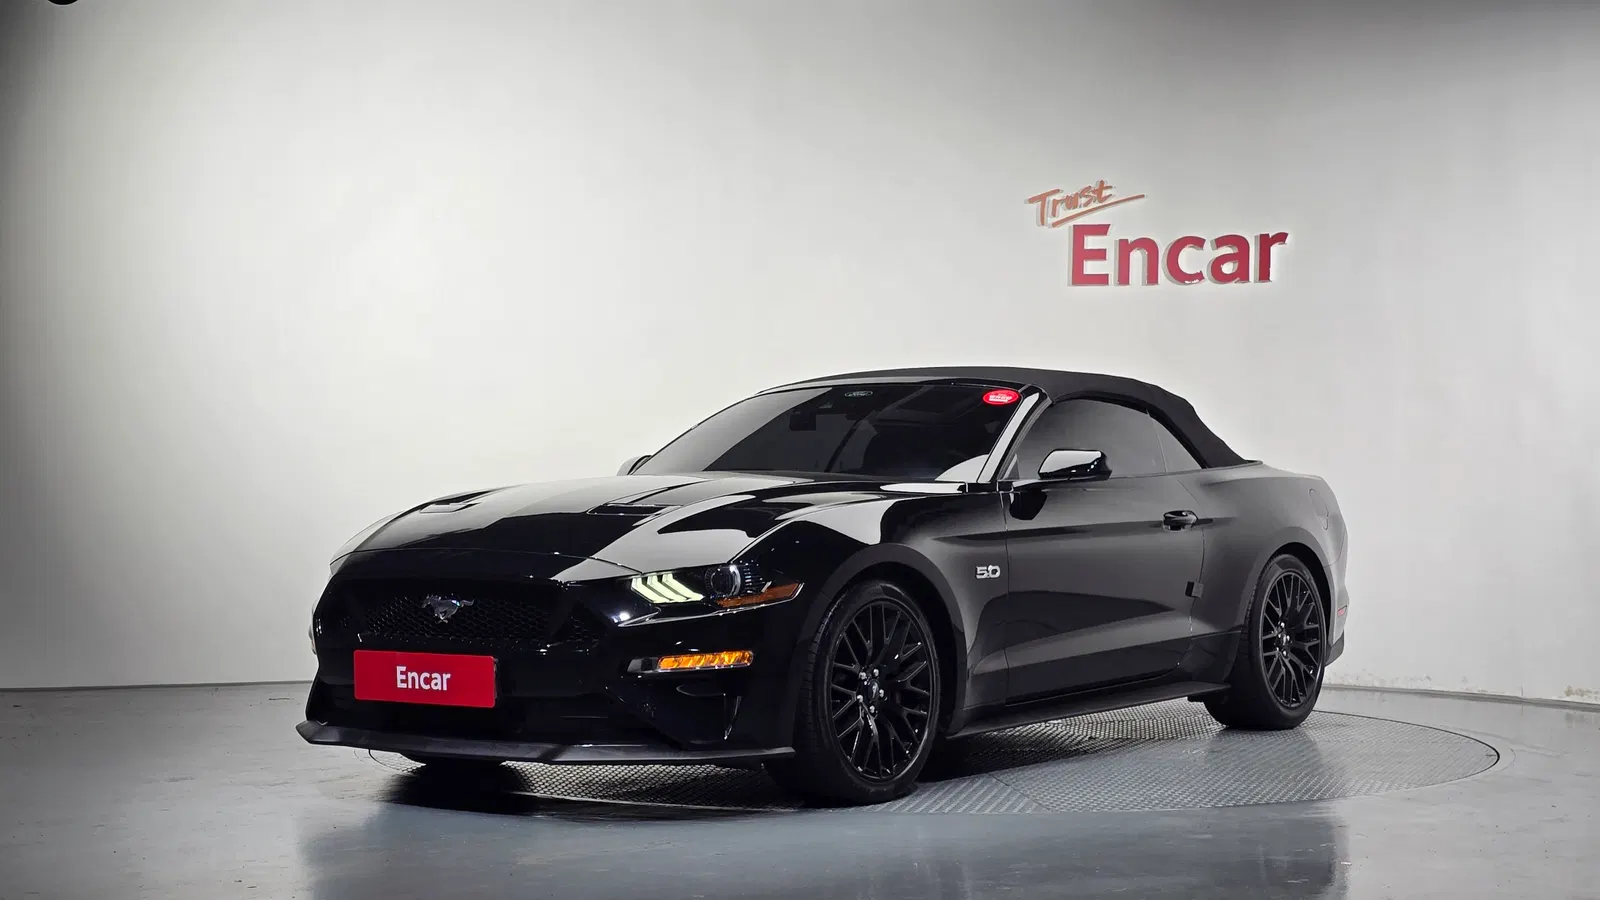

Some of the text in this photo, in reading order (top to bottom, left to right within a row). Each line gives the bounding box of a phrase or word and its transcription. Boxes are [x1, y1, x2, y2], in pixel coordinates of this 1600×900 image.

[1027, 179, 1114, 226] Trust
[1070, 223, 1289, 286] Encar
[396, 665, 451, 691] Encar
